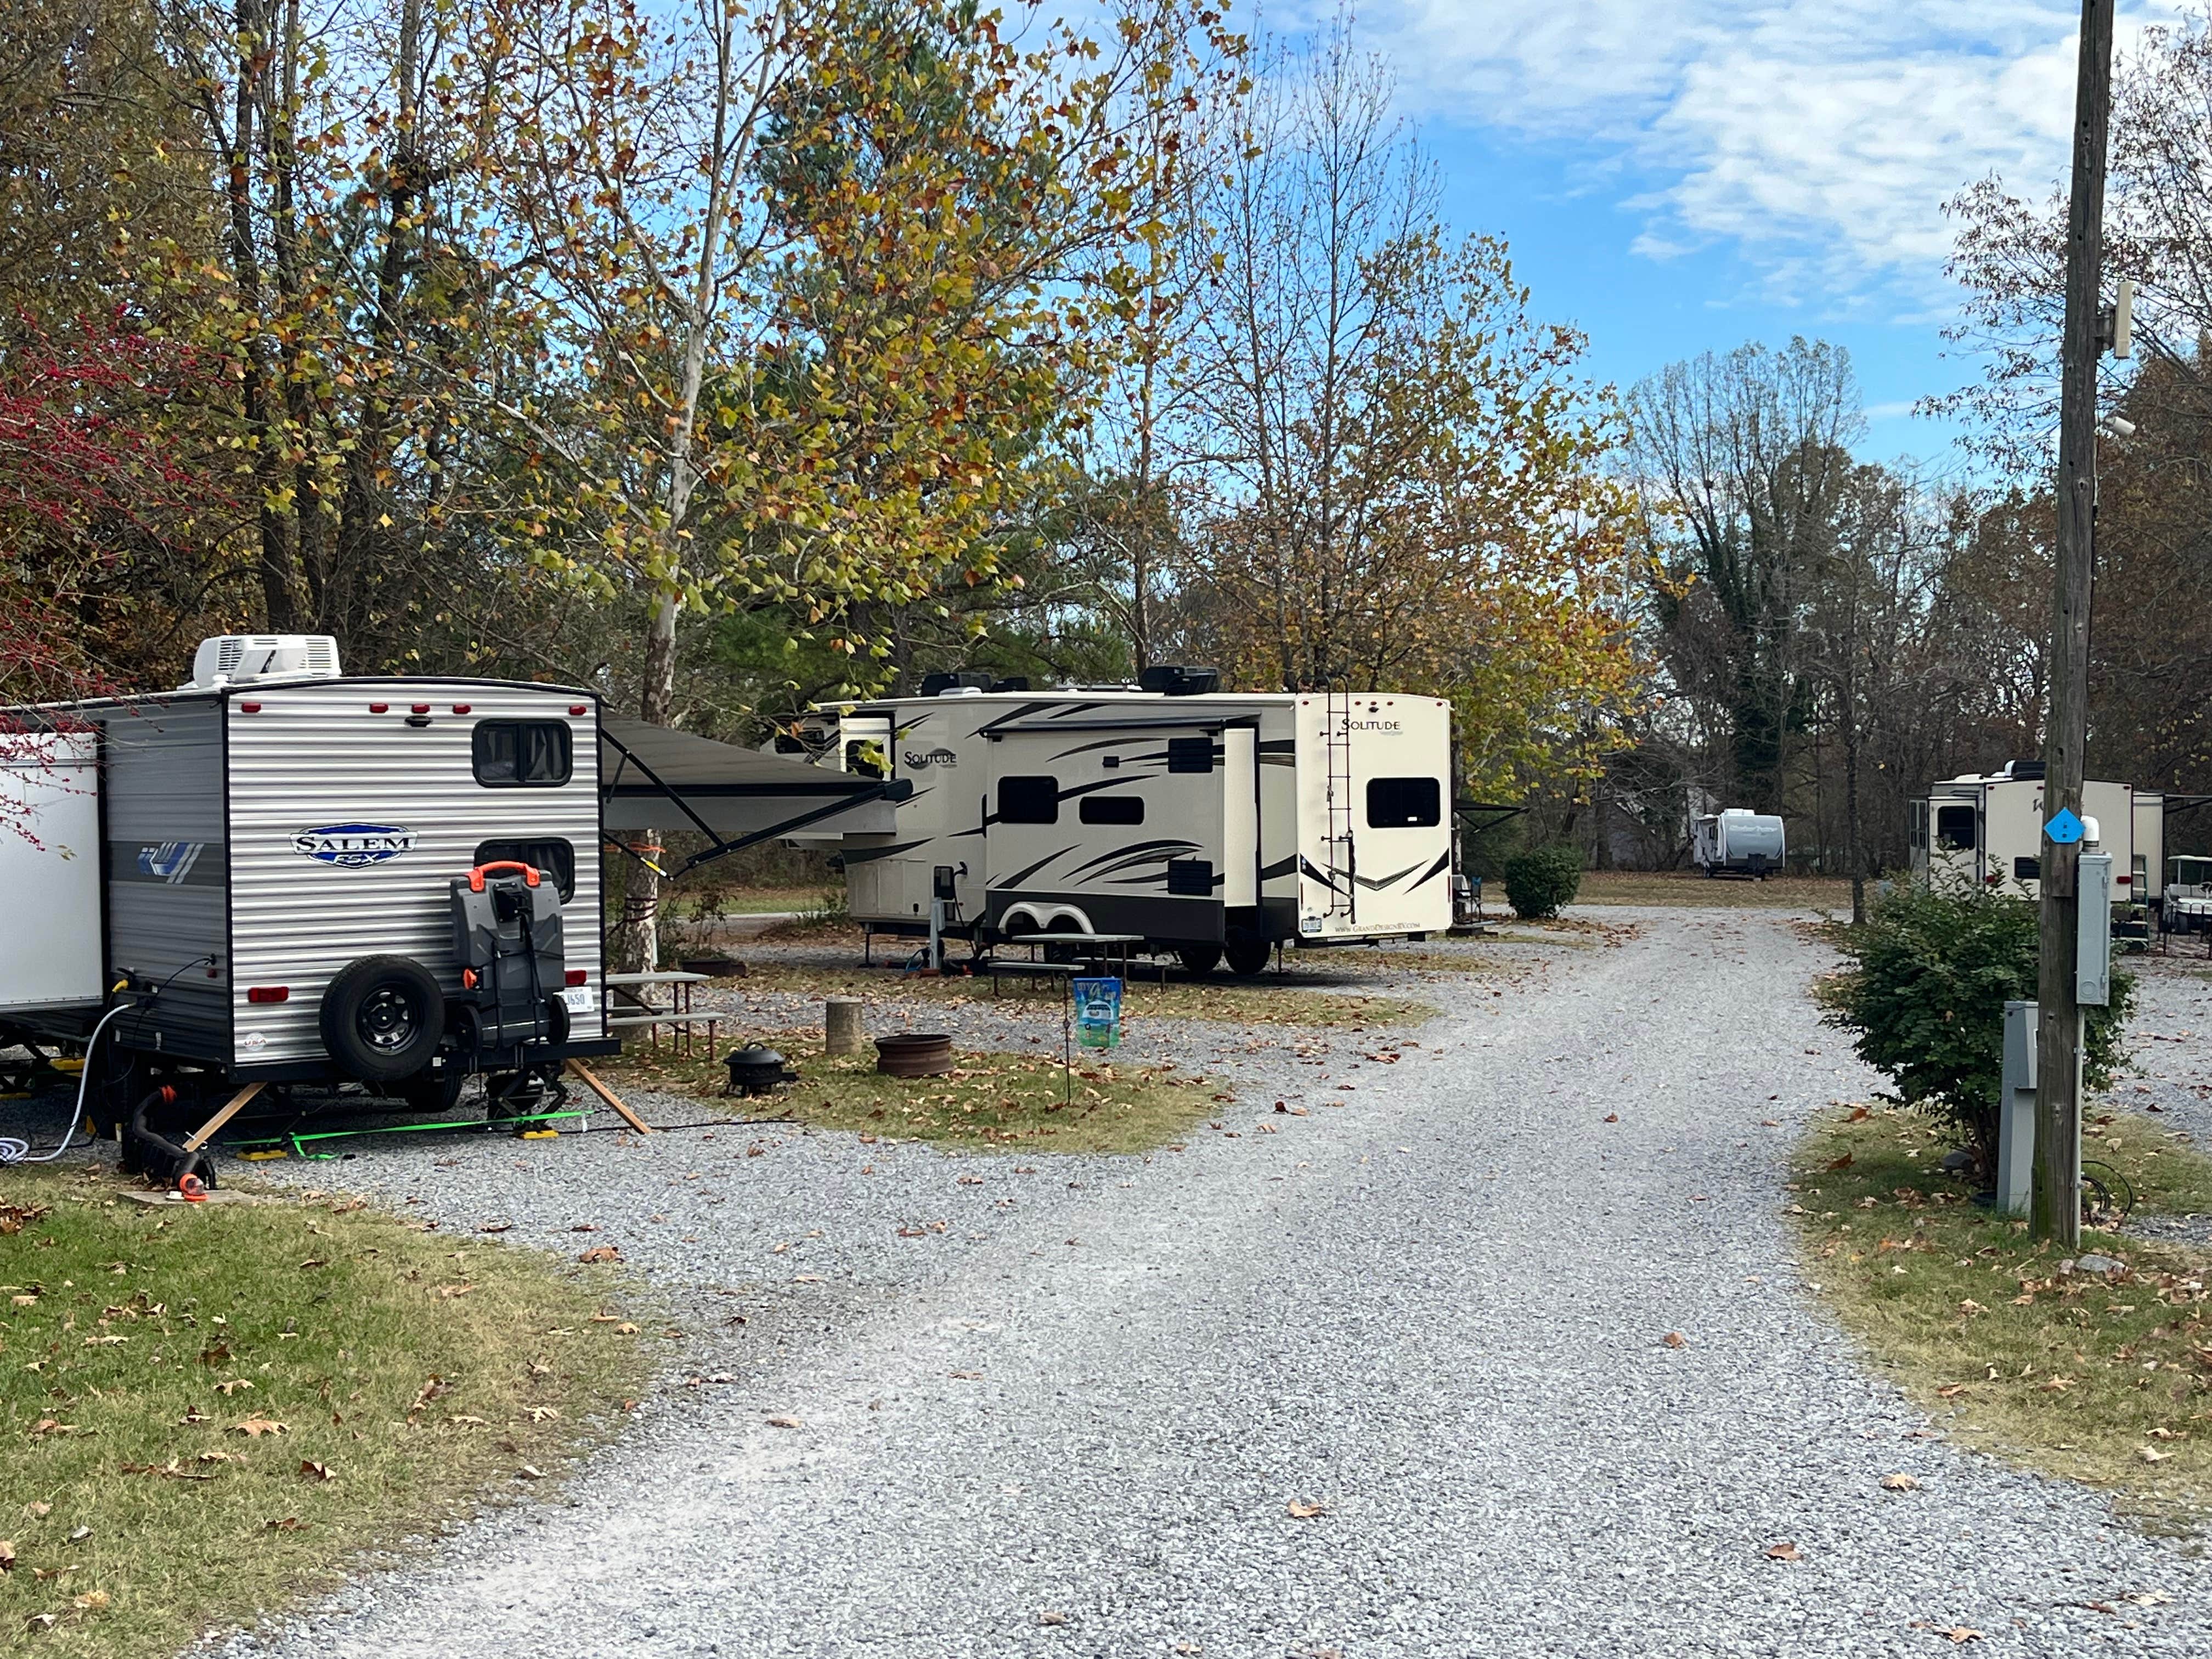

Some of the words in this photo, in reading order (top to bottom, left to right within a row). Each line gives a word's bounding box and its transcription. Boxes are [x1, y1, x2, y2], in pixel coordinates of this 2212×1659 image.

[1341, 719, 1400, 730] SOLITUDE
[904, 751, 957, 764] SOLITUDE
[296, 837, 412, 850] SALEM
[333, 853, 380, 864] FSX
[562, 994, 585, 1005] J650
